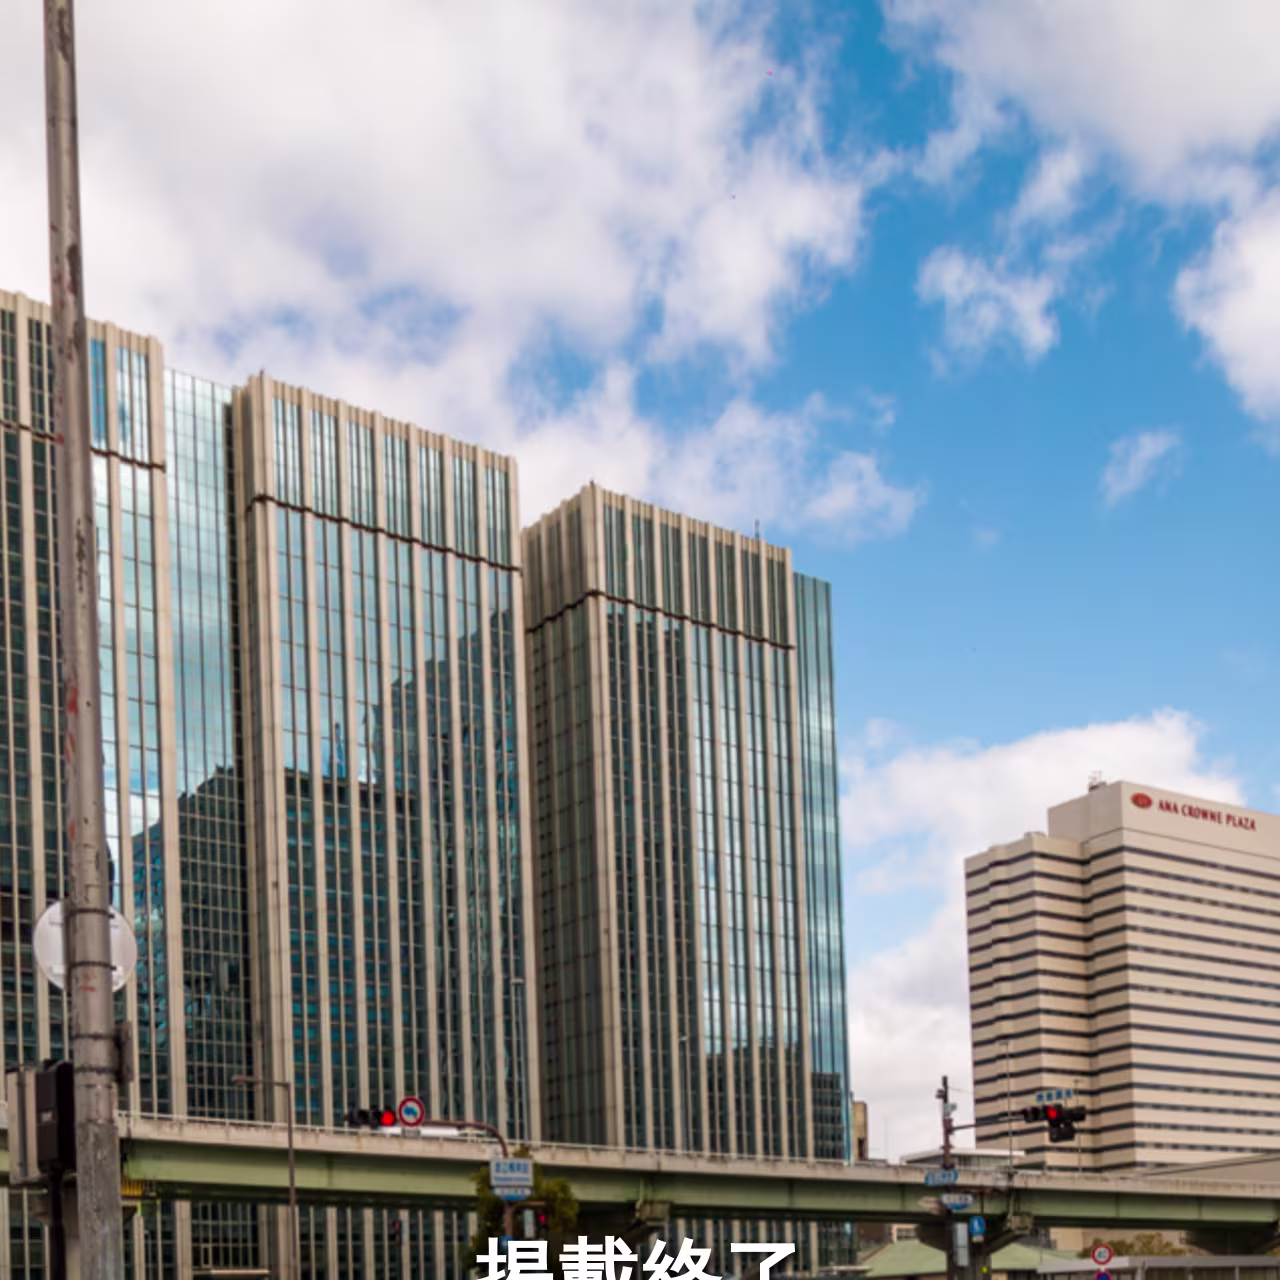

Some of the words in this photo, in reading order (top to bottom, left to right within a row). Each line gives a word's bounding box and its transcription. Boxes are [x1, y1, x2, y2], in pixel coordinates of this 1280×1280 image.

[1158, 799, 1179, 815] ANA
[1181, 803, 1222, 825] CROWNE
[1225, 812, 1257, 832] PLAZA
